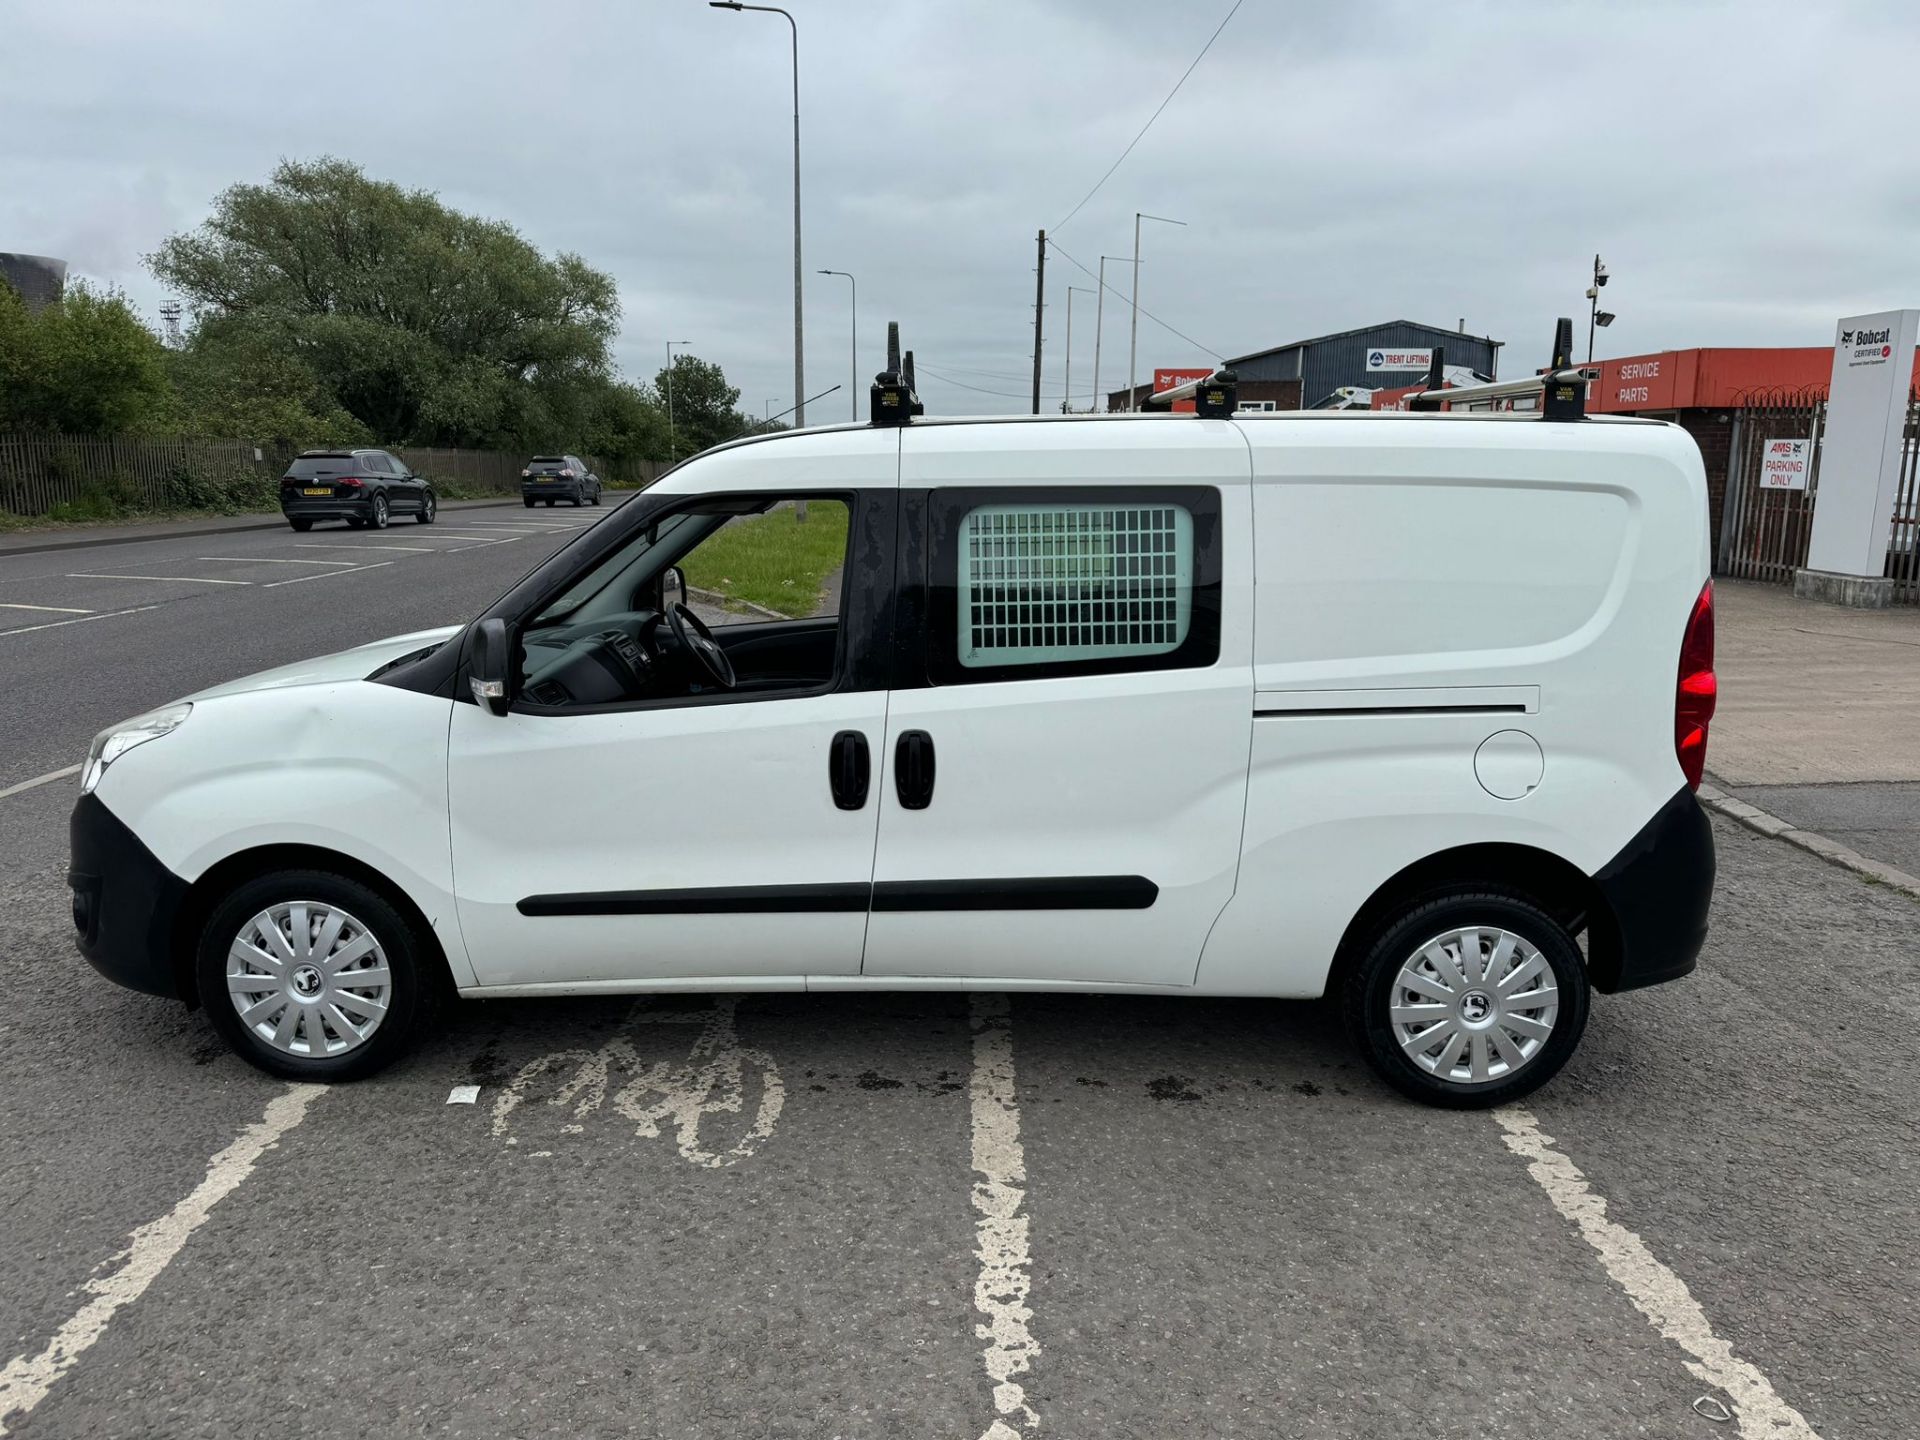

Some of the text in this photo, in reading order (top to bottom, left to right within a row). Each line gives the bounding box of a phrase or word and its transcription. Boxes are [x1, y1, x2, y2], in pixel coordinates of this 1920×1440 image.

[1856, 328, 1890, 346] Bobcat
[1386, 354, 1429, 364] TRENT LIFTING
[1854, 348, 1880, 358] CERTIFIED
[1621, 361, 1660, 380] SERVICE
[1620, 387, 1648, 403] PARTS
[1771, 443, 1791, 453] AMS
[1765, 460, 1803, 473] PARKING
[1770, 474, 1793, 486] ONLY
